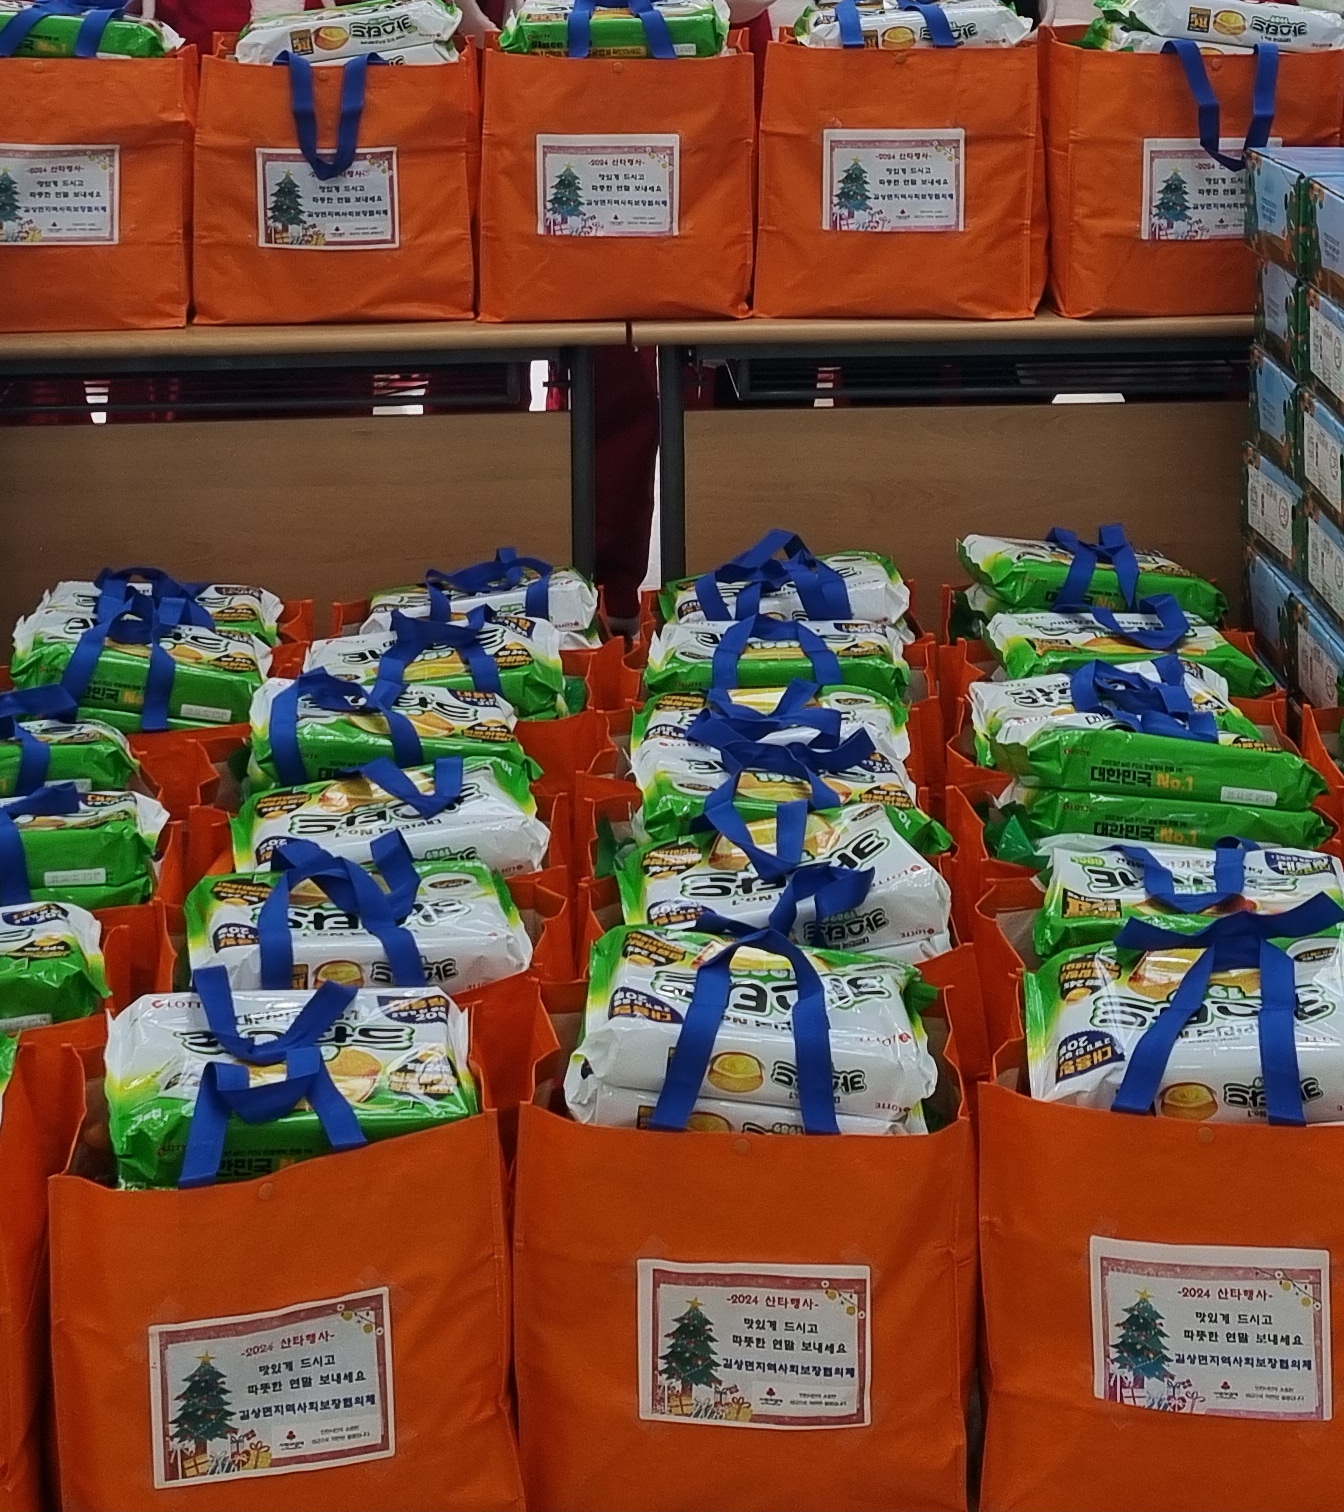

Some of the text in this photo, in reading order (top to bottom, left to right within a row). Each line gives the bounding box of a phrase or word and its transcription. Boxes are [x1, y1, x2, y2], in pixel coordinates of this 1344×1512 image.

[1090, 765, 1153, 788] 대한민국
[1156, 773, 1195, 791] No.1
[1092, 821, 1156, 842] 대한민국
[1160, 826, 1199, 844] No.1
[1059, 1045, 1114, 1077] 대용량
[726, 1294, 819, 1311] -2024 산타행사-
[1177, 1287, 1273, 1302] -2024 산타행사-
[743, 1317, 819, 1334] 맛있게 드시고
[1195, 1311, 1273, 1326] 맛있게 드시고
[240, 1330, 335, 1358] -2024 산타행사-
[732, 1334, 848, 1355] 따뜻한 연말 보내세요
[1183, 1329, 1304, 1347] 따뜻한 연말 보내세요
[258, 1354, 336, 1376] 맛있게 드시고
[247, 1370, 367, 1396] 따뜻한 연말 보내세요
